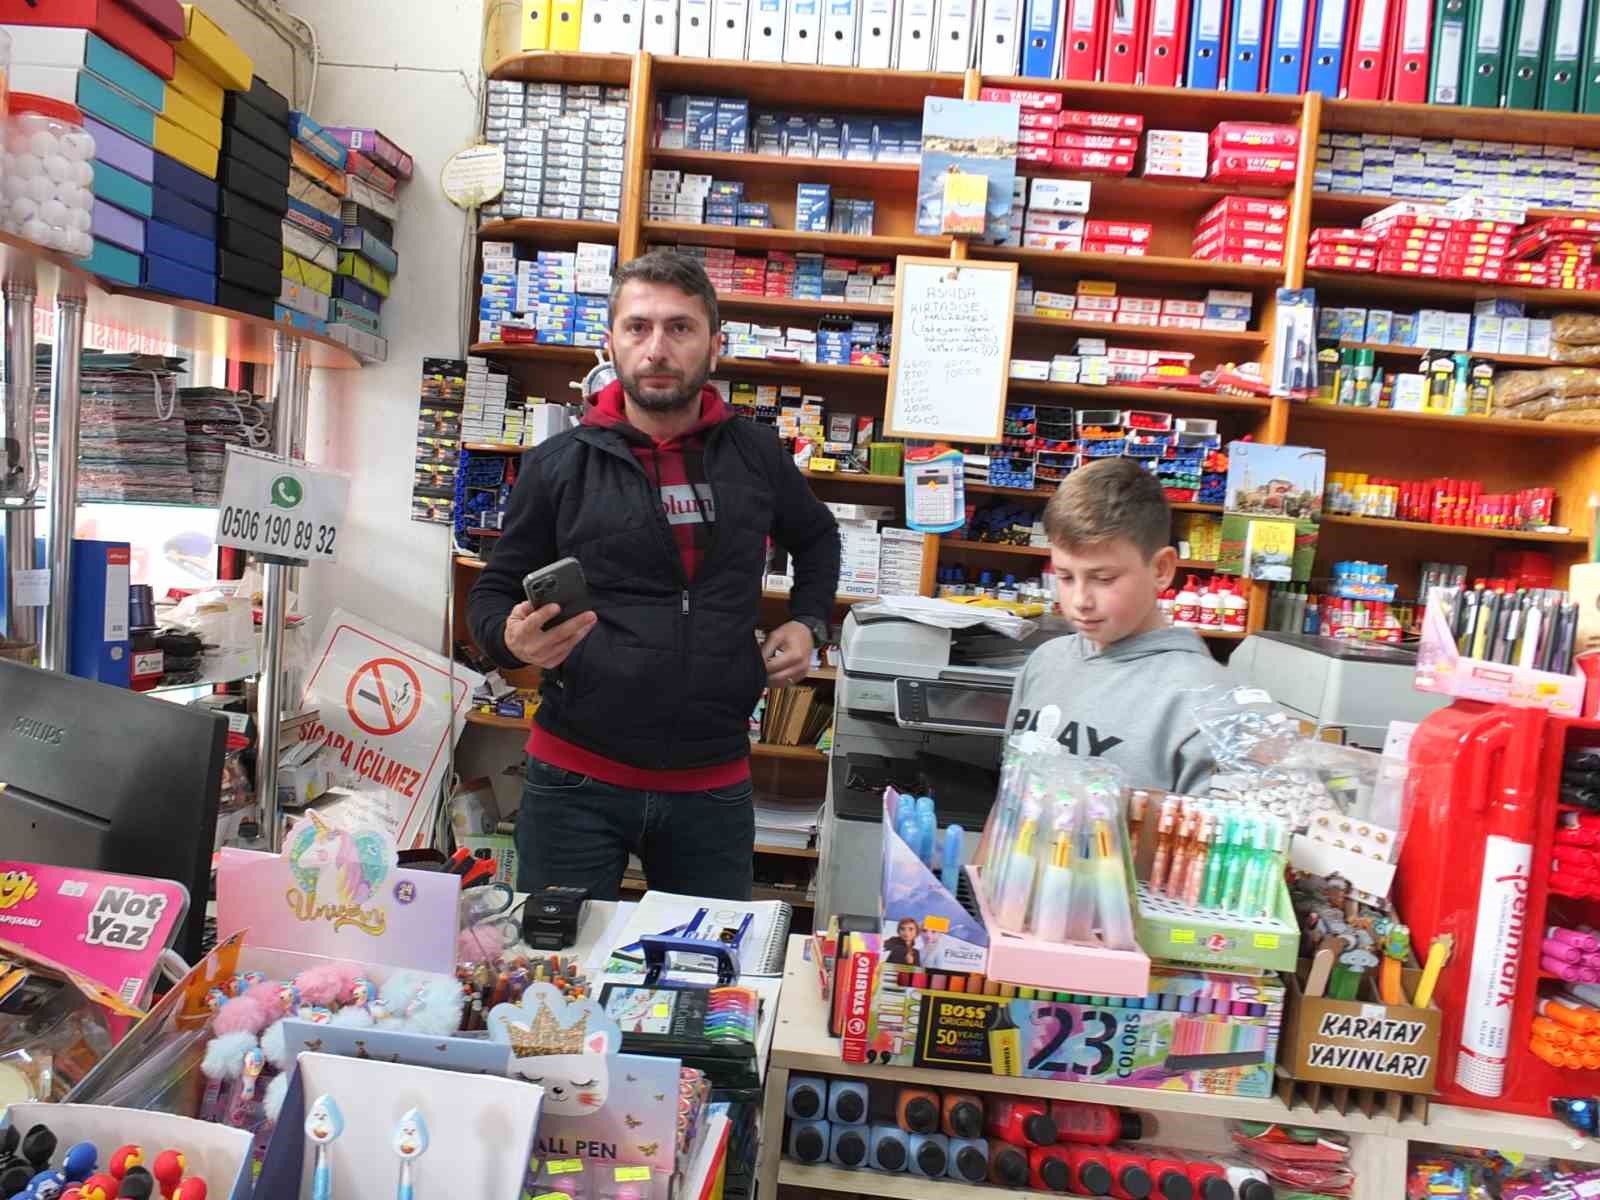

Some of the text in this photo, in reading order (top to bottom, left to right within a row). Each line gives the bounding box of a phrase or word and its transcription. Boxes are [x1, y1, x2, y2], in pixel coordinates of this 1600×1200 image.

[222, 506, 336, 555] 0506 190 89 32
[14, 716, 64, 746] PHILIPS
[353, 739, 421, 798] İÇİLMEZ
[96, 888, 164, 920] Not
[89, 914, 150, 947] Yaz
[853, 956, 871, 1016] STABILO
[940, 1003, 986, 1020] BOSS
[935, 1028, 957, 1045] 50
[1026, 1006, 1118, 1076] 23
[1116, 1013, 1141, 1078] COLORS
[1321, 1014, 1424, 1044] KARATAY
[1309, 1044, 1428, 1077] YAYINLARI
[575, 1140, 617, 1160] PEN
